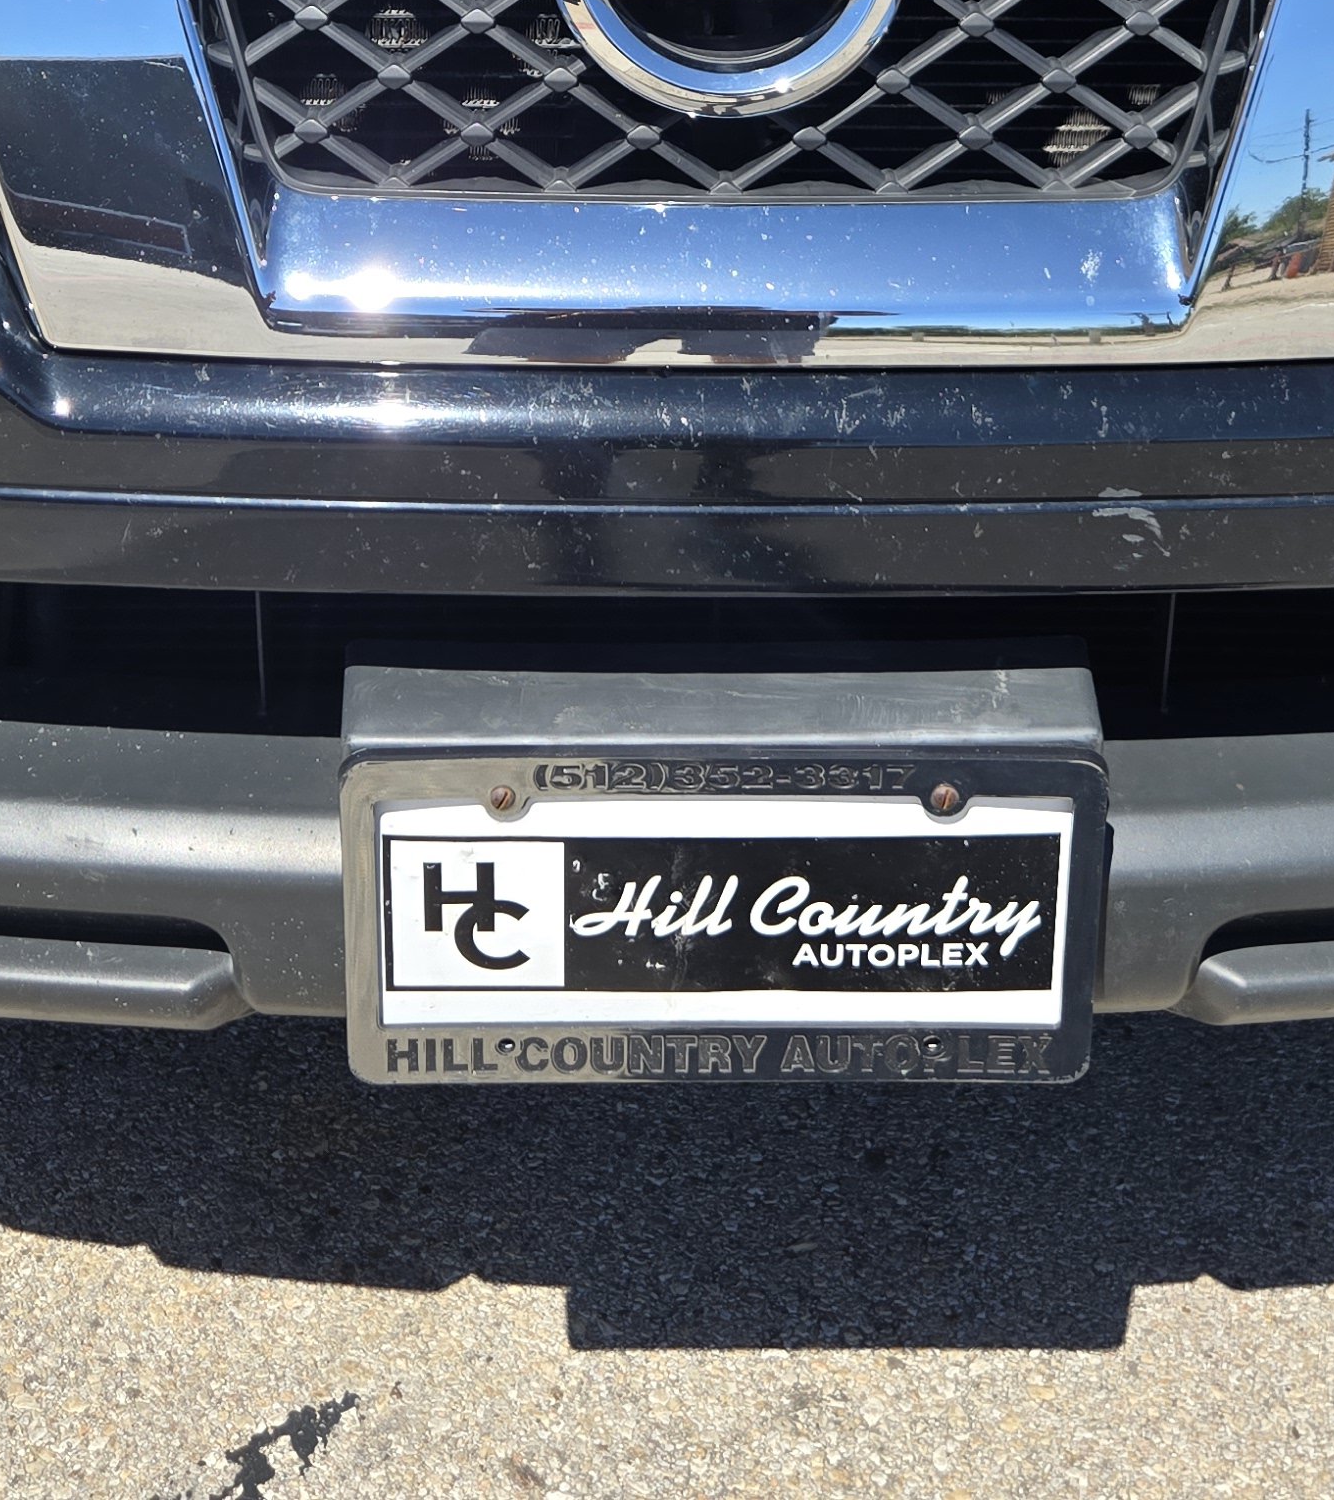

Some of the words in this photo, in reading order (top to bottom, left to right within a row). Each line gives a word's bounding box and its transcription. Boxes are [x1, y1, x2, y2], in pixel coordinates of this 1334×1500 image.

[571, 875, 739, 937] Hill
[749, 875, 1042, 957] Country
[792, 942, 989, 968] AUTOPLEX
[386, 1037, 498, 1073] HILL
[516, 1035, 767, 1074] COUNTRY
